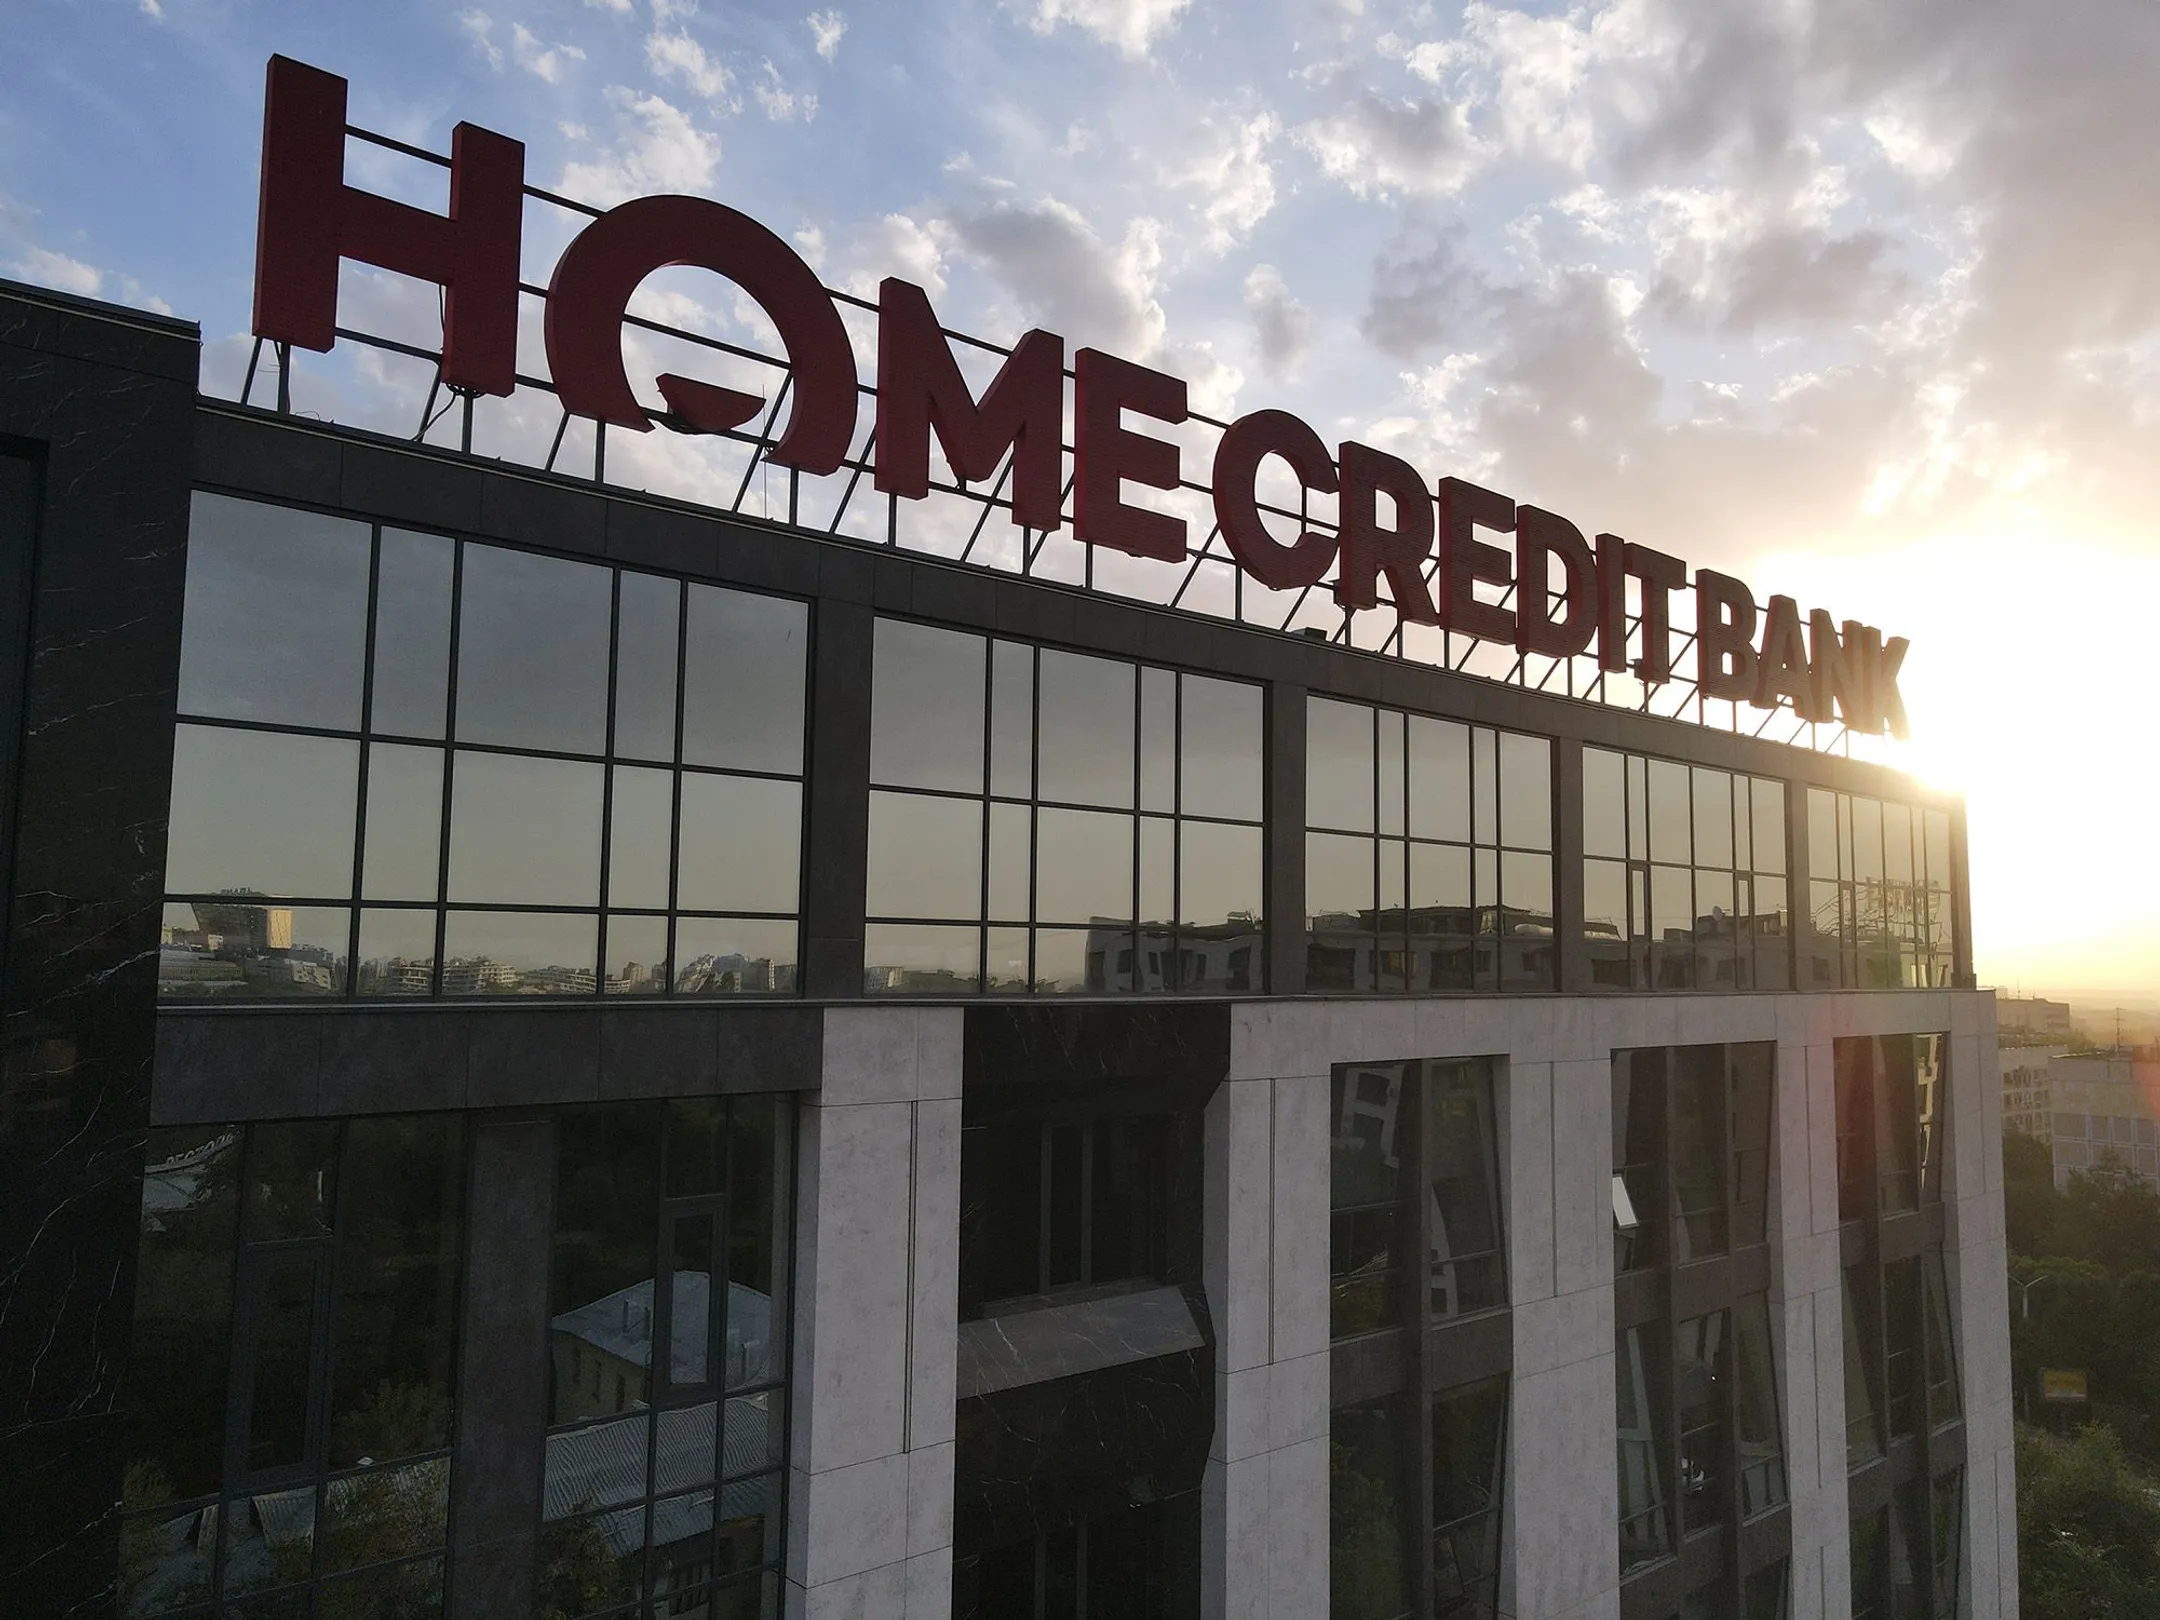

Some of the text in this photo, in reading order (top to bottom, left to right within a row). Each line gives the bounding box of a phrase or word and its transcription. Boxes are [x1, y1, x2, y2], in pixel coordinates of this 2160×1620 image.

[253, 53, 1910, 741] HOME CREDIT BANK
